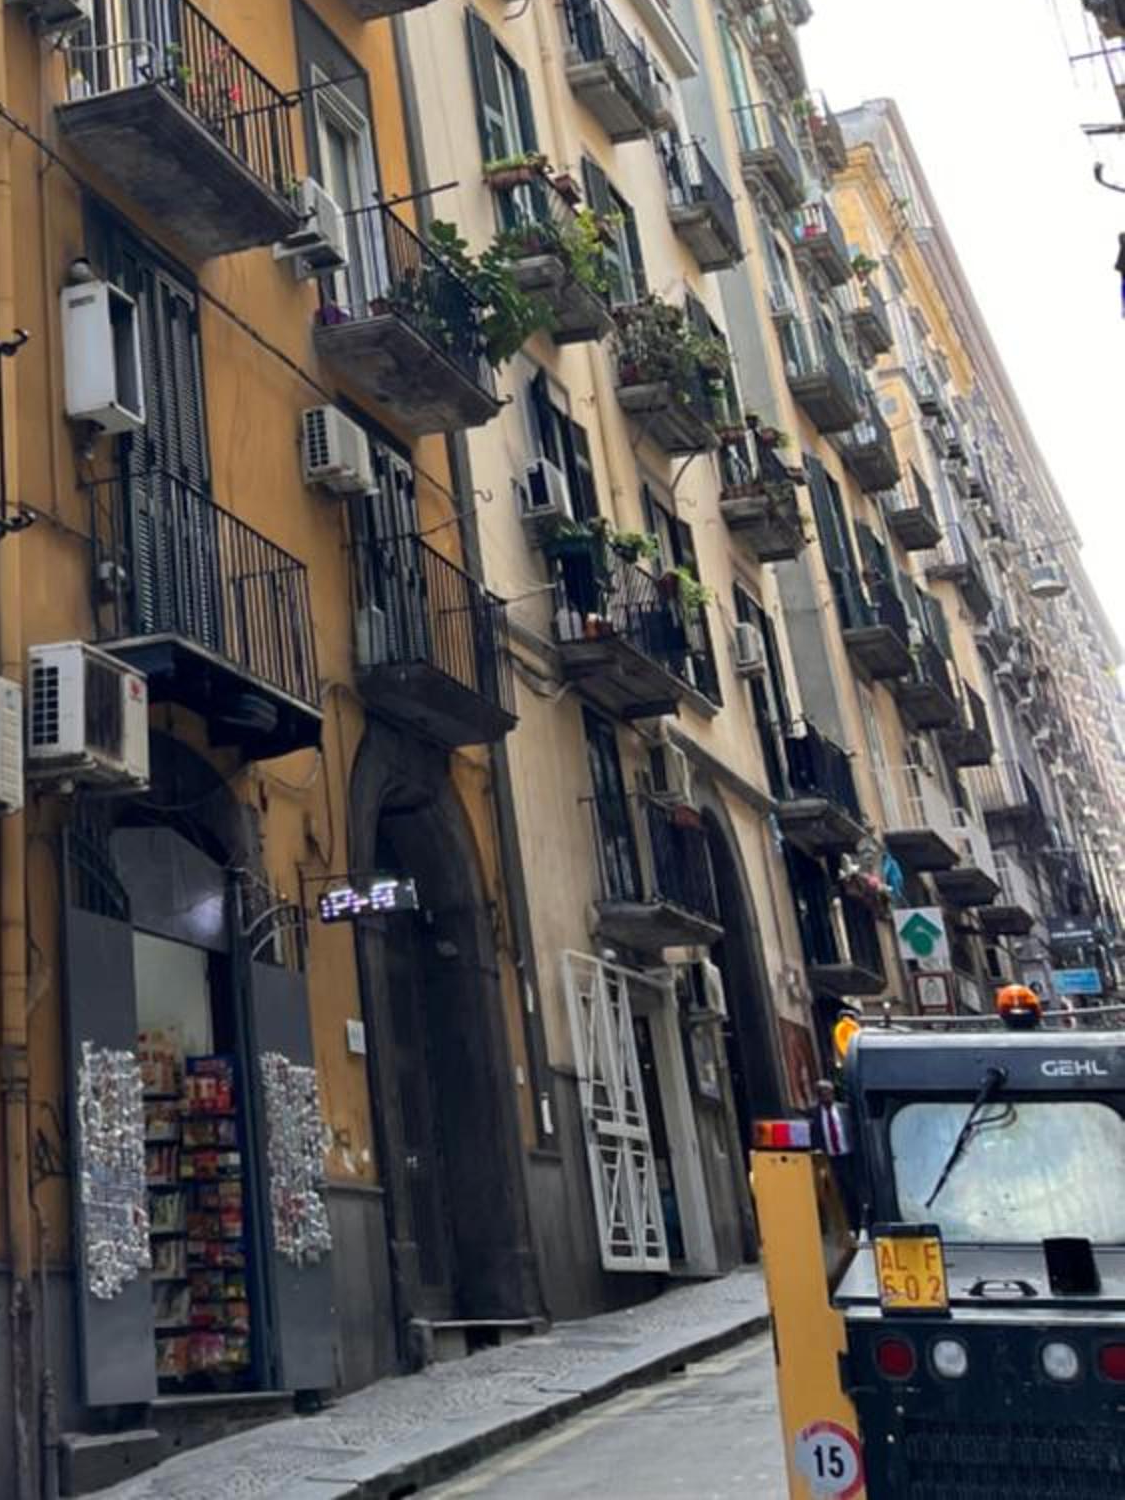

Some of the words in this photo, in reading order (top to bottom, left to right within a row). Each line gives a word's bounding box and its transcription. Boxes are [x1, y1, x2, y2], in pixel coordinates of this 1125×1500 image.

[1041, 1060, 1109, 1077] GEHL
[881, 1244, 908, 1272] AL
[922, 1242, 938, 1271] F
[813, 1444, 845, 1479] 15
